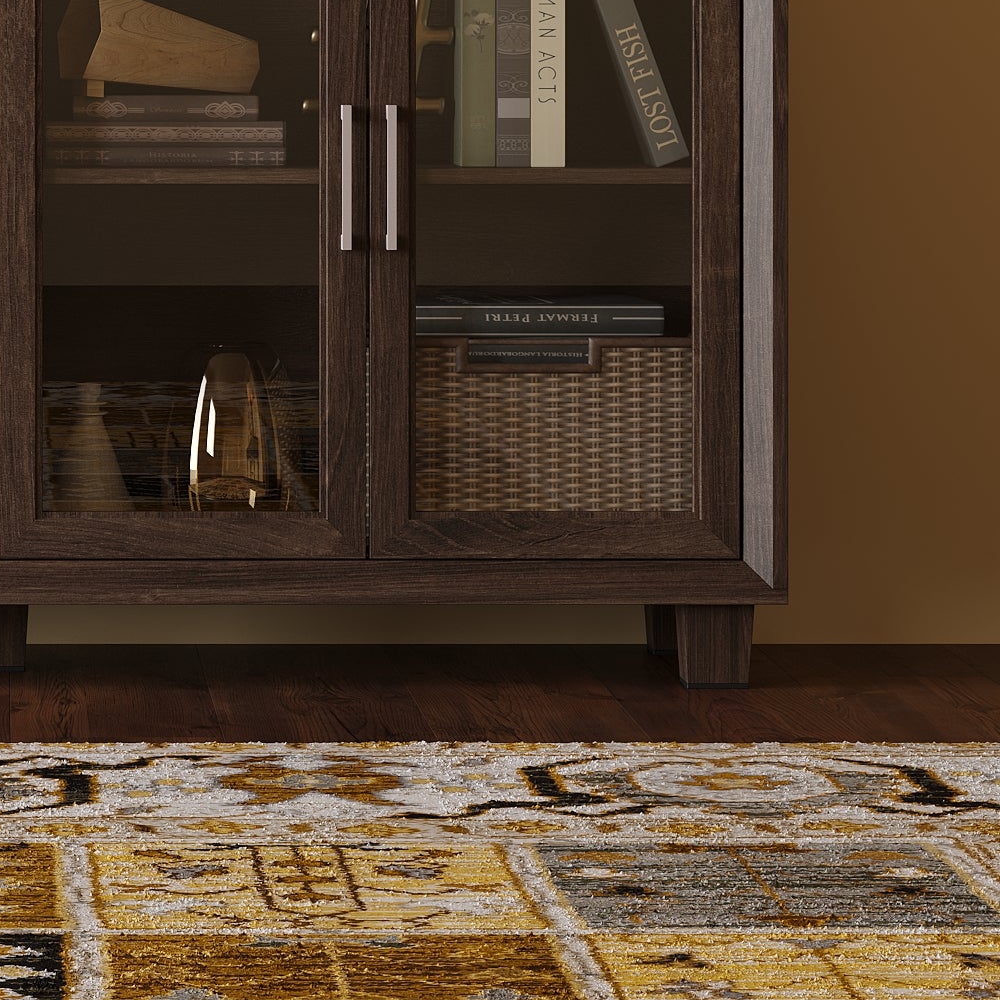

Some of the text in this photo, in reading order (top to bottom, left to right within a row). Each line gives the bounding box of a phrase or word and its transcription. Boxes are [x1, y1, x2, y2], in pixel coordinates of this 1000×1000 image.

[538, 50, 556, 103] ACTS
[614, 22, 679, 150] LOST FISH
[485, 313, 599, 324] FERMAT PETRI
